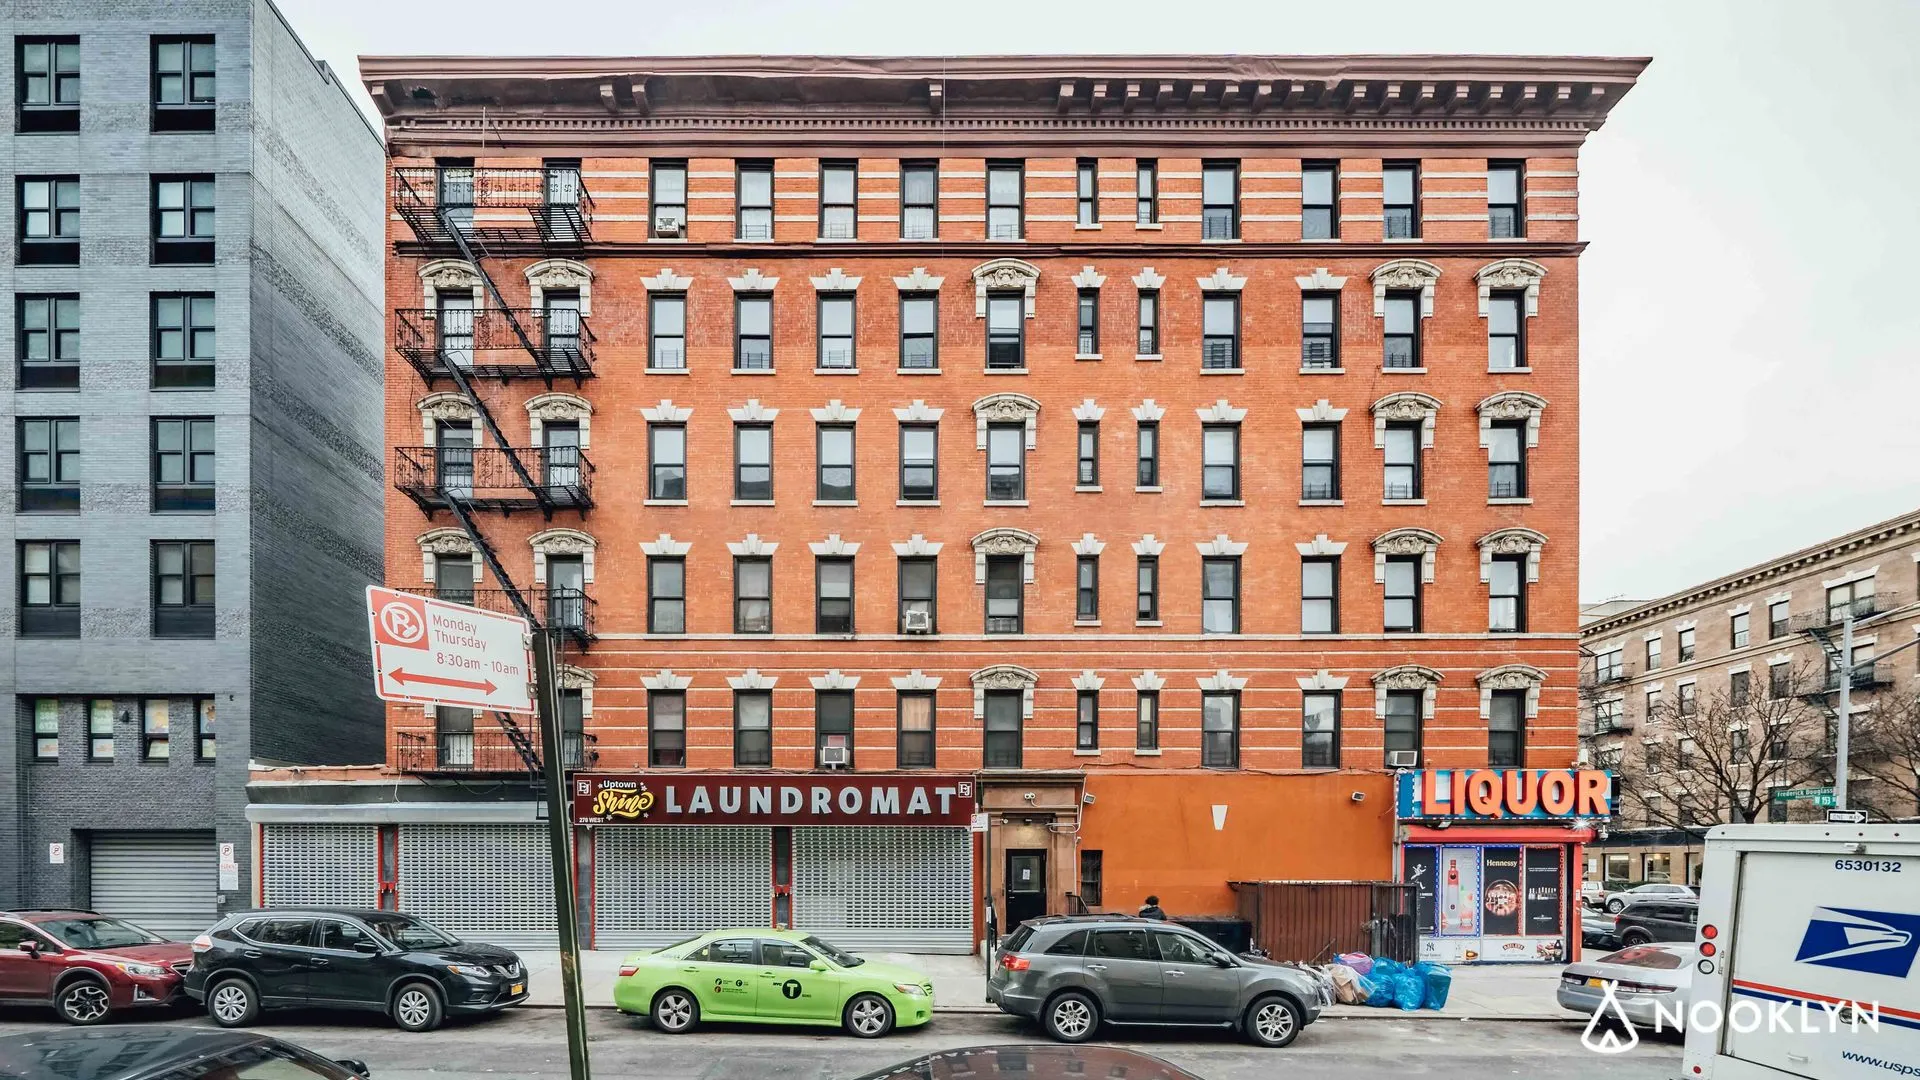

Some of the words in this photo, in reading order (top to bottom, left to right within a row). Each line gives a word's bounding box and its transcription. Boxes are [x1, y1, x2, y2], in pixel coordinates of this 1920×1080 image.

[432, 614, 478, 635] Monday
[434, 629, 487, 652] Thursday
[436, 652, 481, 670] 8:30am
[491, 661, 519, 676] 10am
[603, 780, 637, 789] Uptown
[1422, 770, 1610, 819] LIQUOR
[593, 789, 654, 816] Shine
[666, 786, 956, 814] LAUNDROMAT
[1486, 859, 1518, 867] Hennessy
[1835, 859, 1902, 873] 6530132
[1842, 1050, 1920, 1077] www.usps
